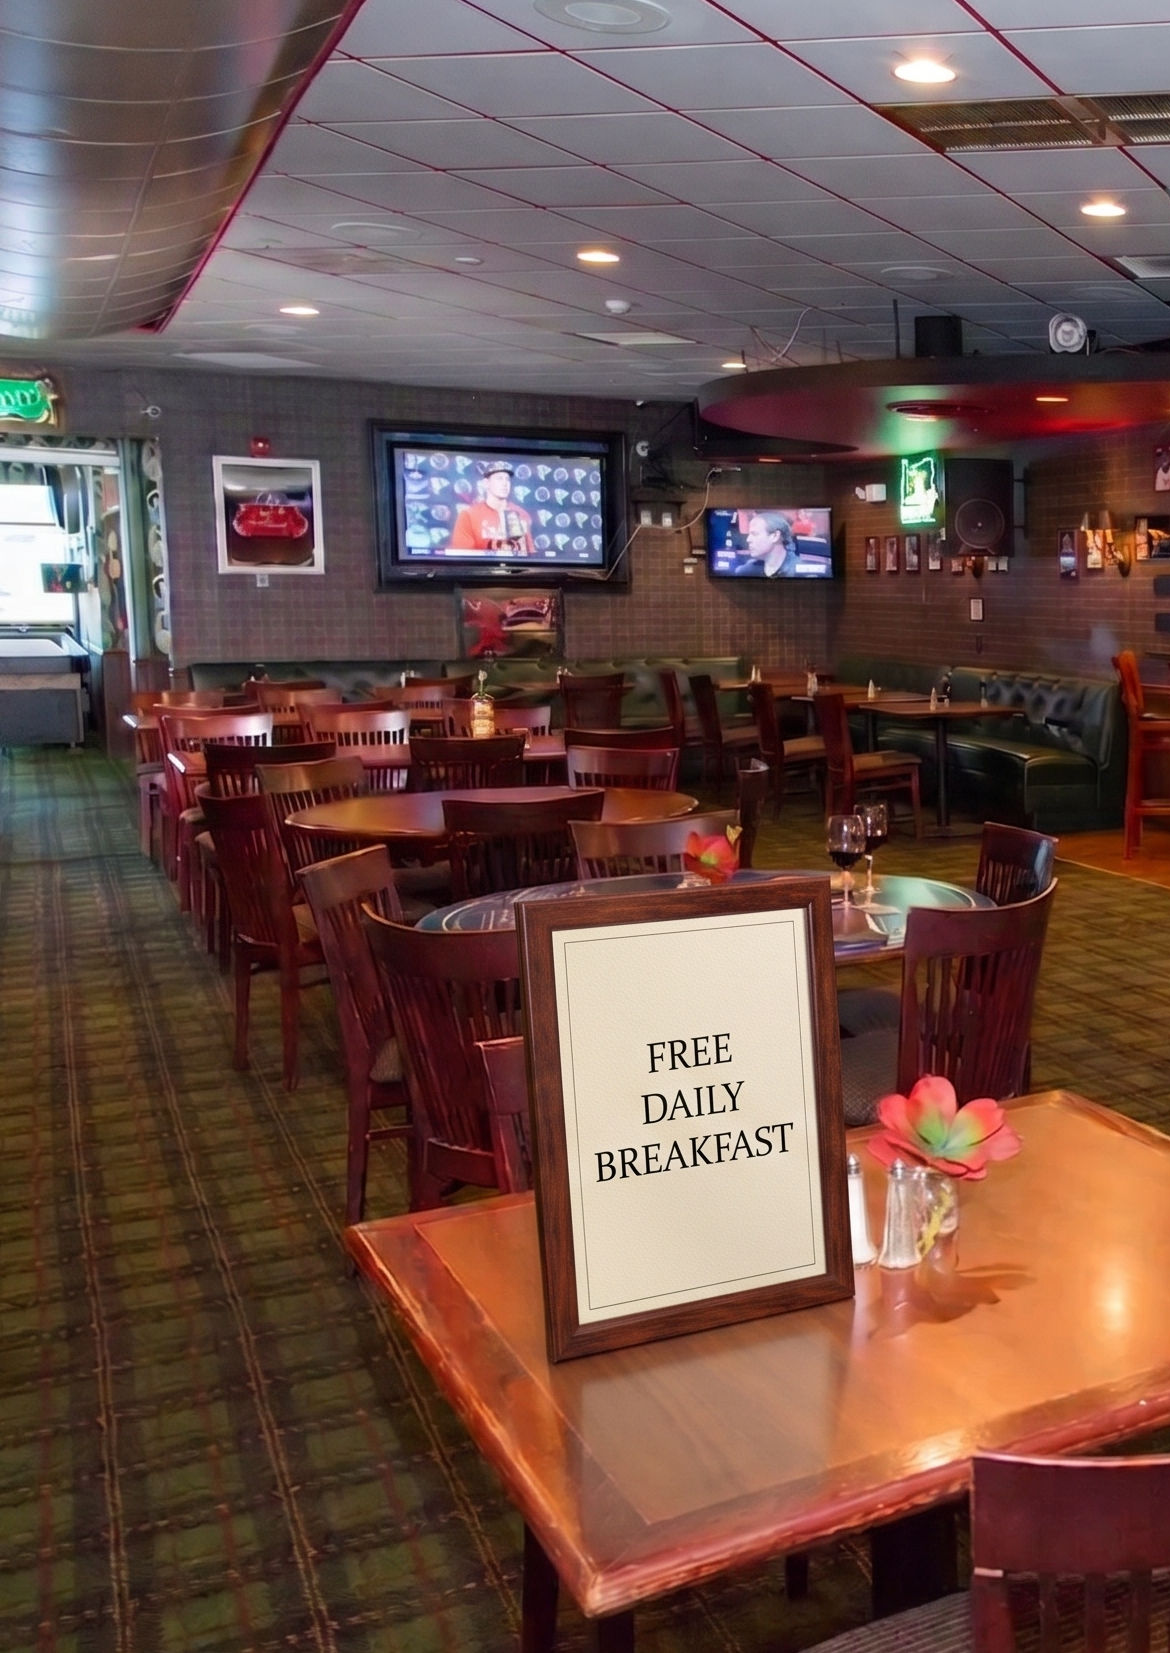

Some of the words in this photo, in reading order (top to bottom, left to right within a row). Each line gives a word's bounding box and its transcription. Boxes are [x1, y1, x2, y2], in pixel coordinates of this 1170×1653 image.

[647, 1033, 733, 1074] FREE
[641, 1081, 745, 1125] DAILY
[595, 1123, 794, 1183] BREAKFAST
